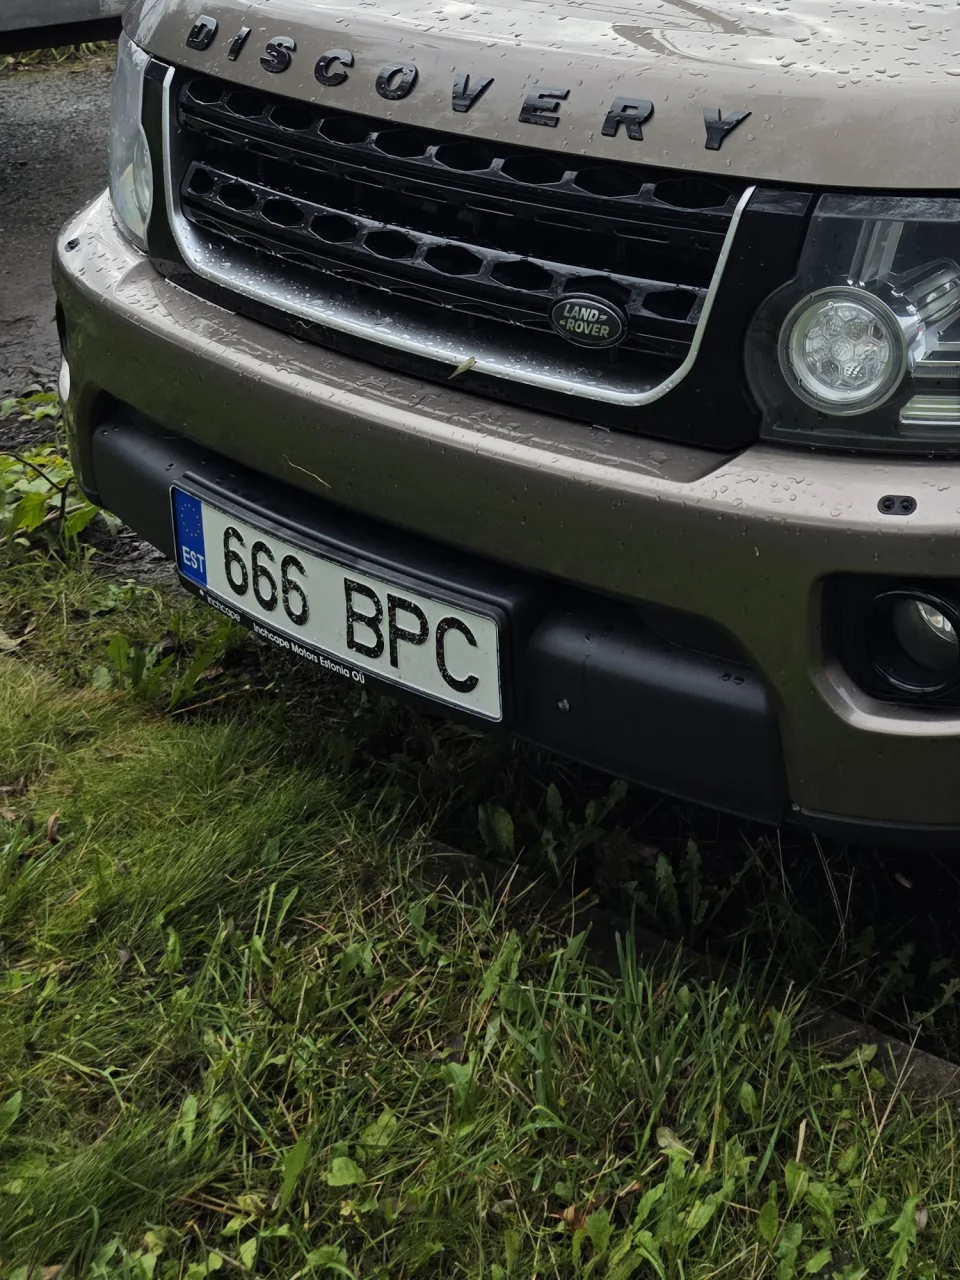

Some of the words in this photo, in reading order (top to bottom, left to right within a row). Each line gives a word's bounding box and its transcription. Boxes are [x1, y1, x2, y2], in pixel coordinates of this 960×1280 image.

[186, 14, 752, 150] DISCOVERY
[563, 304, 600, 322] LAND
[565, 319, 610, 338] ROVER
[182, 545, 204, 574] EST
[223, 526, 310, 626] 666
[344, 577, 480, 693] BPC
[291, 642, 318, 663] Motors
[319, 656, 350, 678] Estonia
